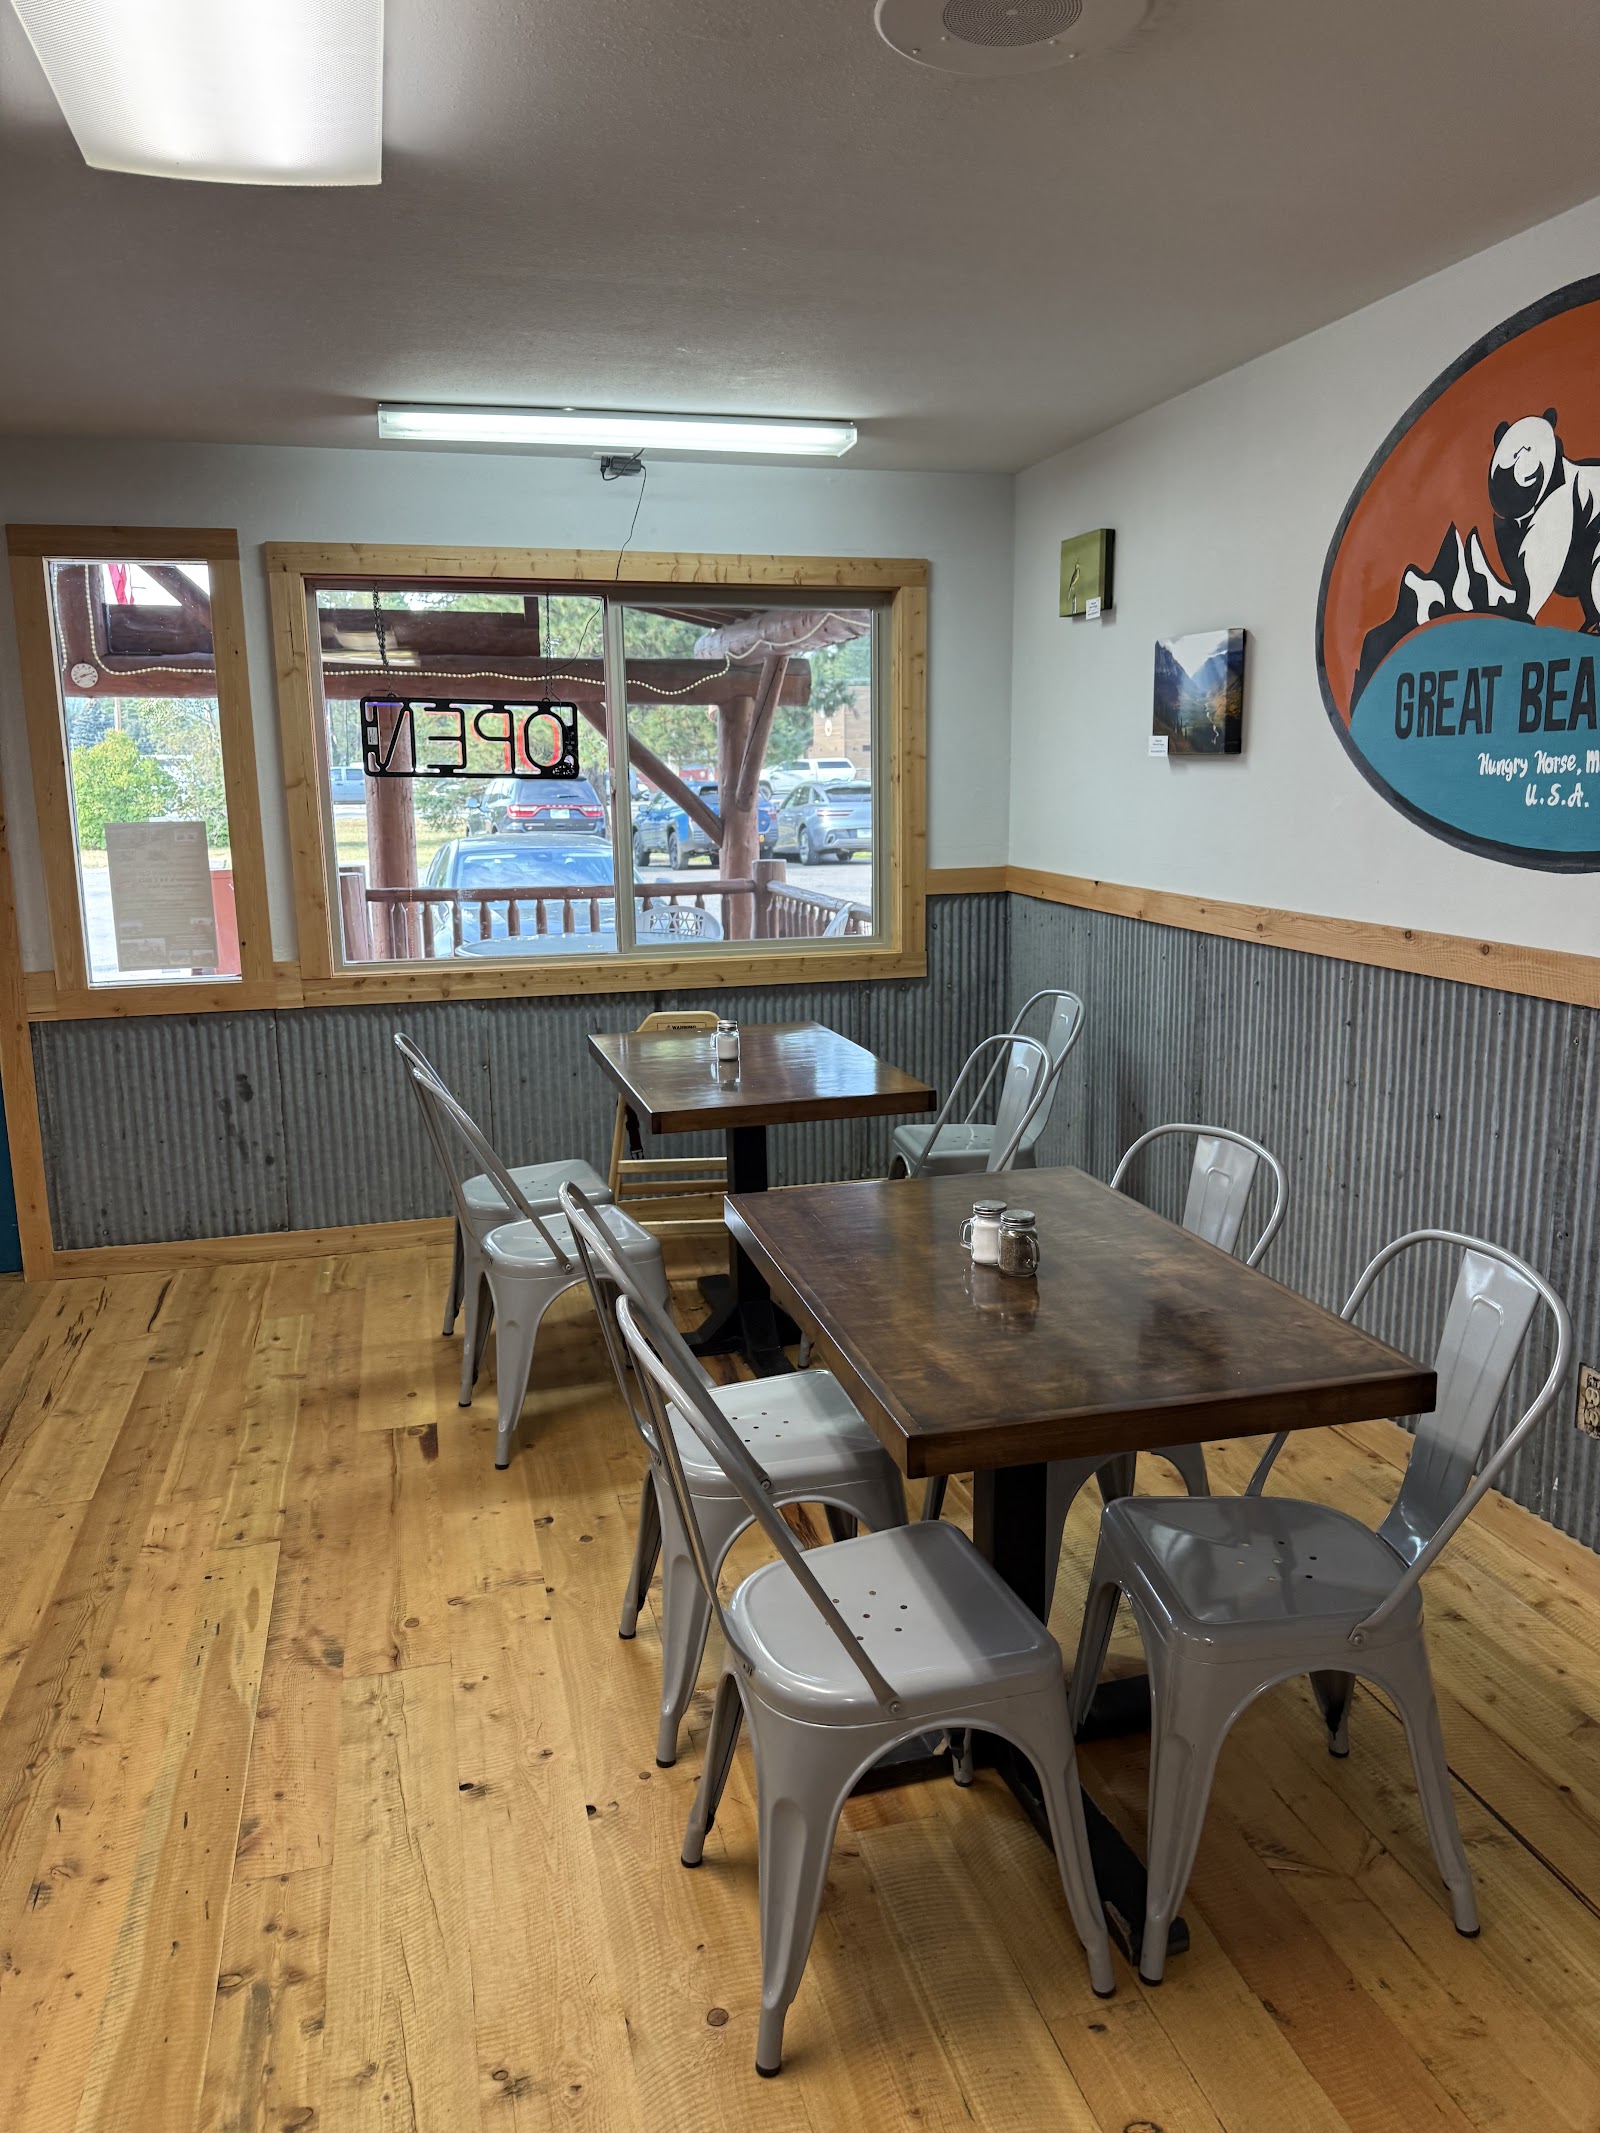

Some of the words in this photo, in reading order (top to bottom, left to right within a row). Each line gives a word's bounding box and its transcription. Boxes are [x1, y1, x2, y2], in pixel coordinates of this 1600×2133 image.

[1394, 664, 1503, 740] GREAT
[1477, 751, 1529, 782] Hungry
[1533, 749, 1583, 776] Horse,
[1525, 782, 1590, 809] U.S.A.
